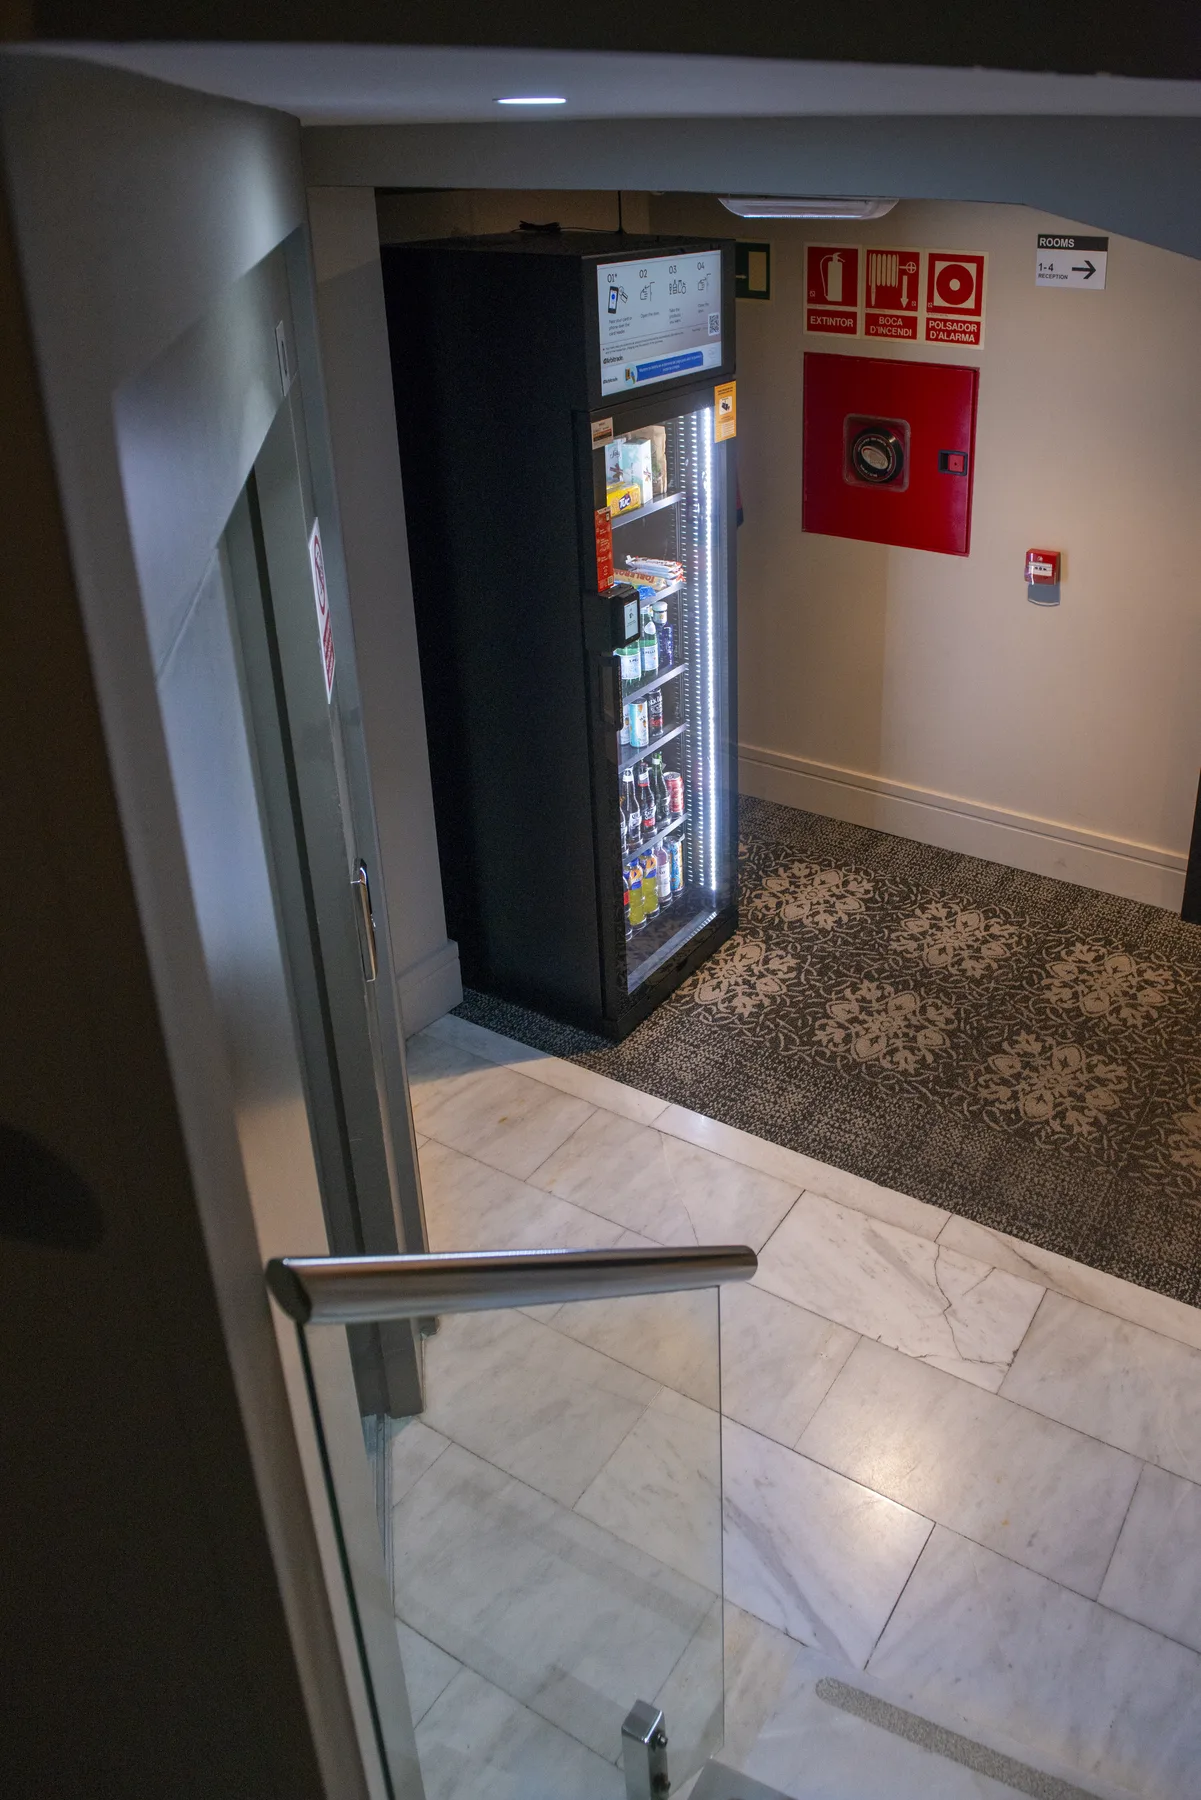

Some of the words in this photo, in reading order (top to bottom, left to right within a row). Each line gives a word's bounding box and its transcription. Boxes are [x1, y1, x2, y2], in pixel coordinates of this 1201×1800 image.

[1039, 237, 1075, 248] ROOMS
[668, 265, 677, 274] 03
[697, 262, 705, 270] 04
[639, 269, 648, 278] 02
[810, 316, 854, 328] EXTINTOR
[878, 317, 903, 326] BOCA
[929, 321, 978, 333] POLSADOR
[869, 326, 912, 337] D'INCENDI
[929, 332, 975, 343] D'ALARMA
